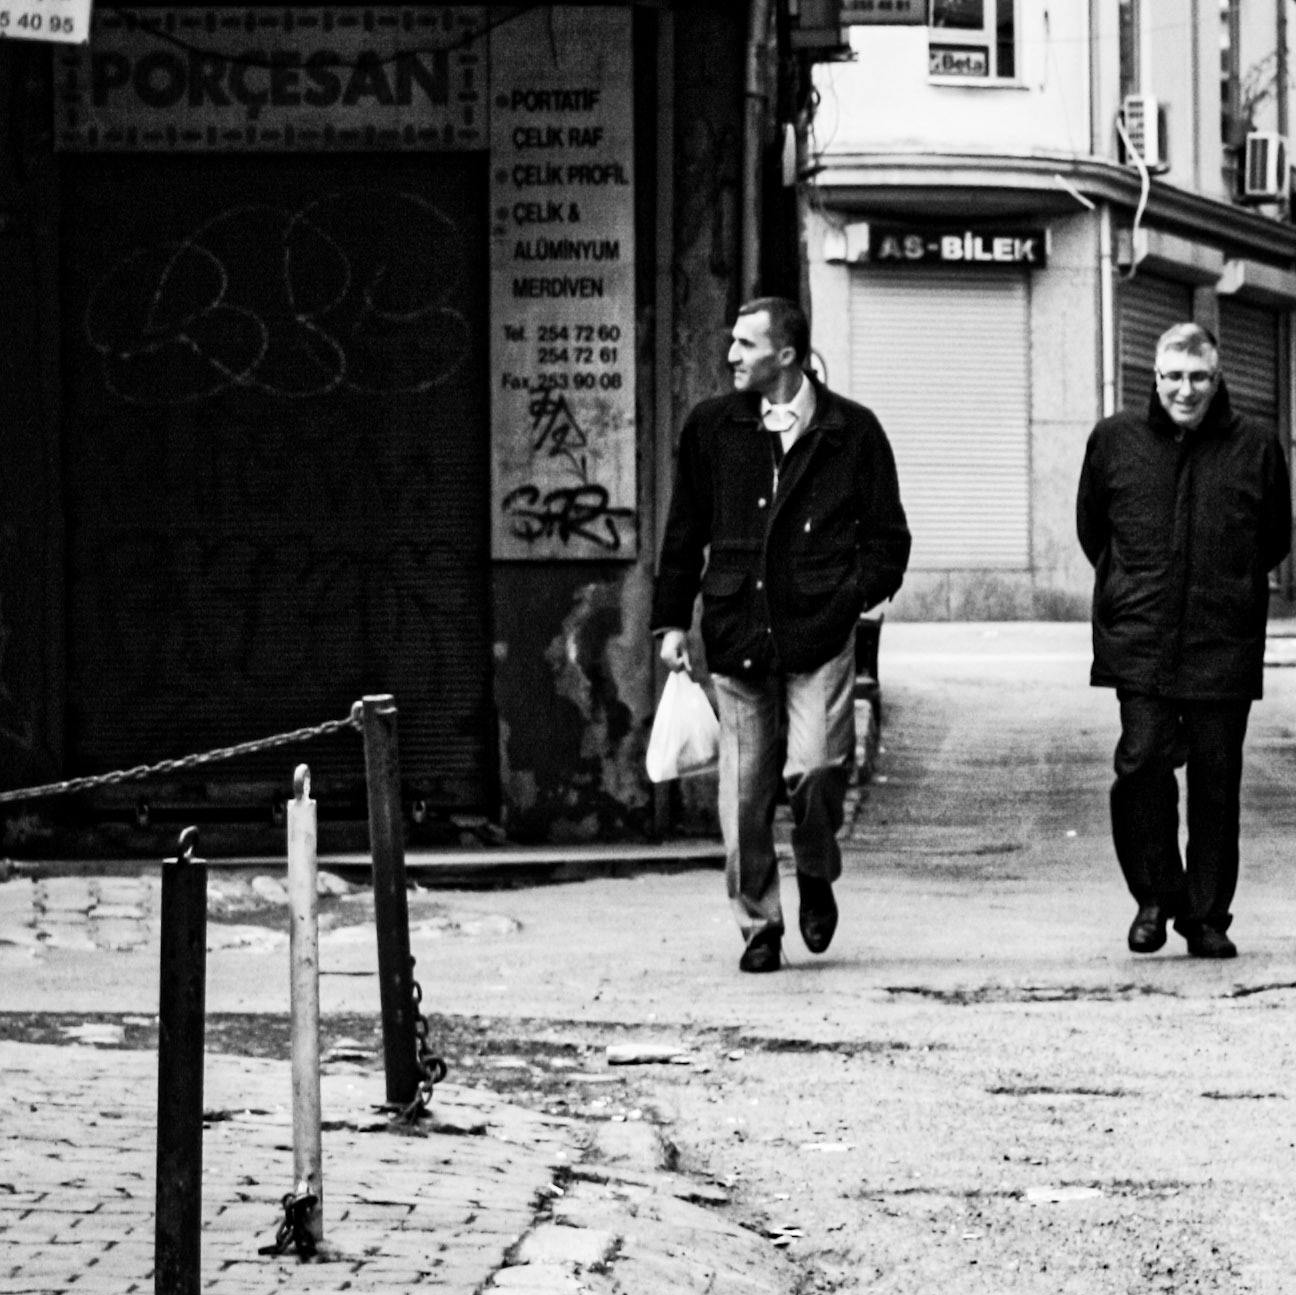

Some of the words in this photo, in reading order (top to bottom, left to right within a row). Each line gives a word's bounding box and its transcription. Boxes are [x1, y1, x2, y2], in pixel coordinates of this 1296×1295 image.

[18, 12, 42, 31] 40
[50, 14, 73, 33] 95
[91, 47, 450, 120] PORÇESAN
[511, 88, 601, 113] PORTATİF
[511, 125, 564, 150] ÇELİK
[569, 128, 604, 147] RAF
[511, 164, 564, 187] ÇELİK
[569, 163, 630, 185] PROFİL
[511, 202, 564, 226] ÇELİK
[514, 238, 620, 261] ALÜMİNYUM
[512, 276, 604, 299] MERDİVEN
[538, 325, 568, 342] 254
[574, 325, 594, 342] 72
[598, 324, 621, 342] 60
[538, 347, 568, 364] 254
[574, 347, 594, 364] 72
[599, 346, 618, 364] 61
[573, 372, 595, 390] 90
